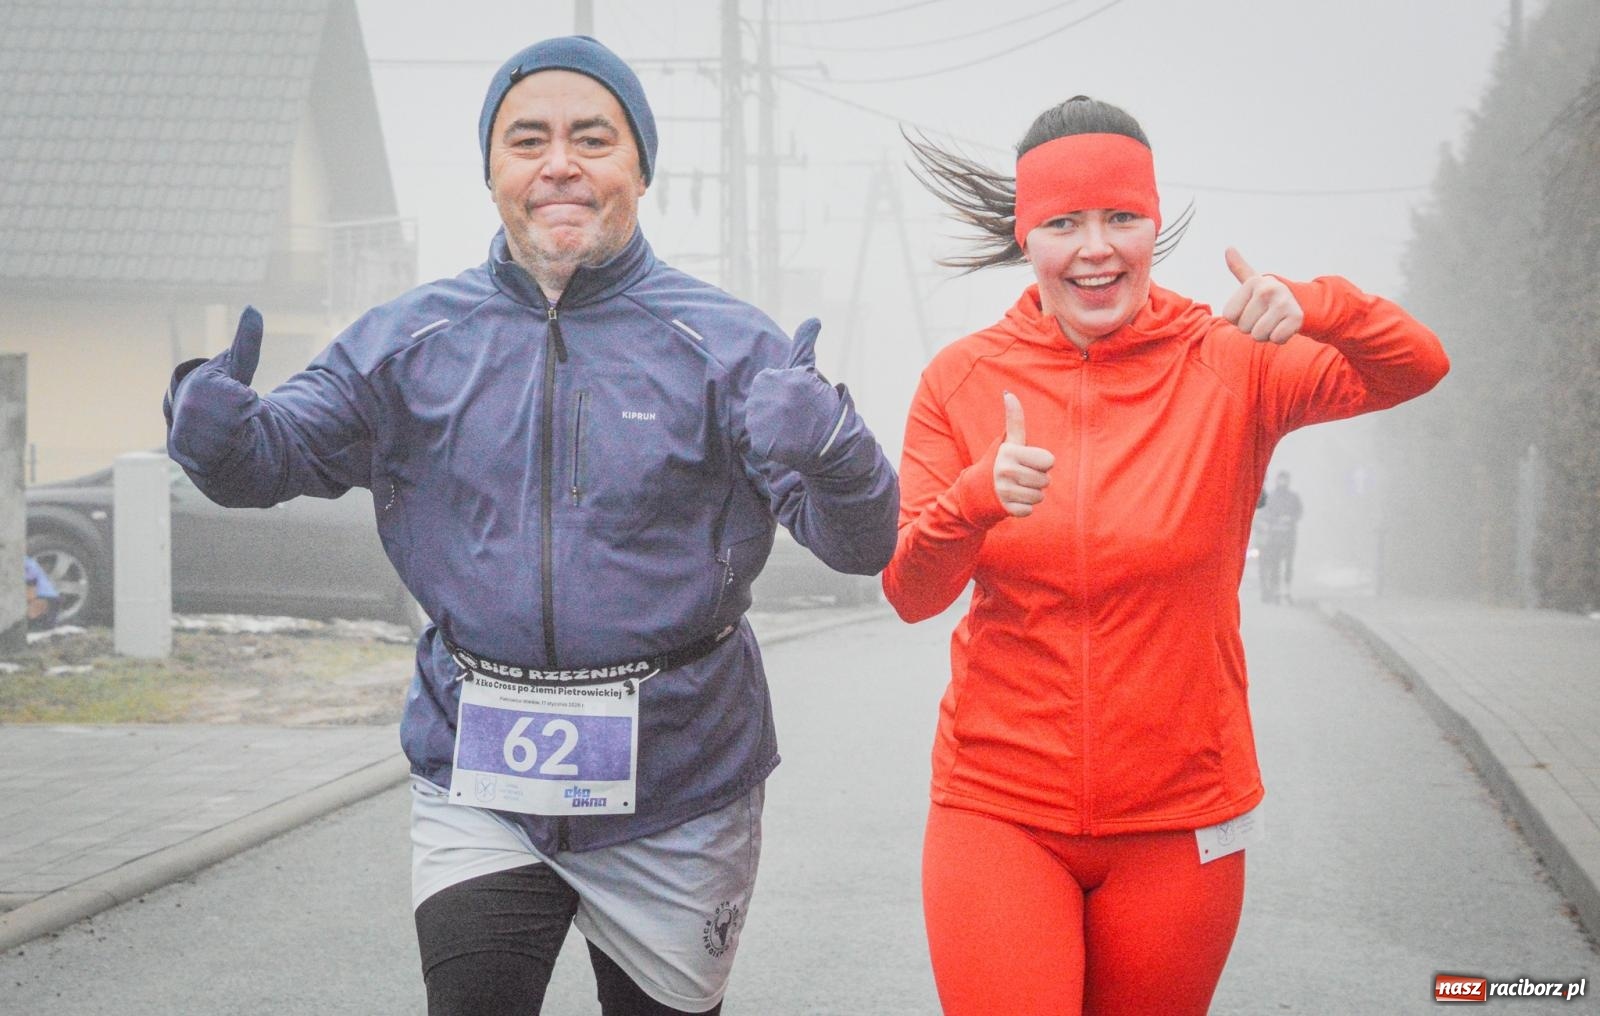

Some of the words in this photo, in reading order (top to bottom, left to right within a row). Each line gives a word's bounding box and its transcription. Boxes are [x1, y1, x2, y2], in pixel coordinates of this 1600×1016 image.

[622, 411, 656, 420] KIPRUN
[475, 678, 480, 686] X
[481, 679, 493, 688] Eko
[493, 681, 517, 691] Cross
[518, 685, 529, 694] po
[530, 685, 557, 695] Ziemi
[558, 687, 622, 700] Pietrowickiej
[503, 716, 579, 776] 62
